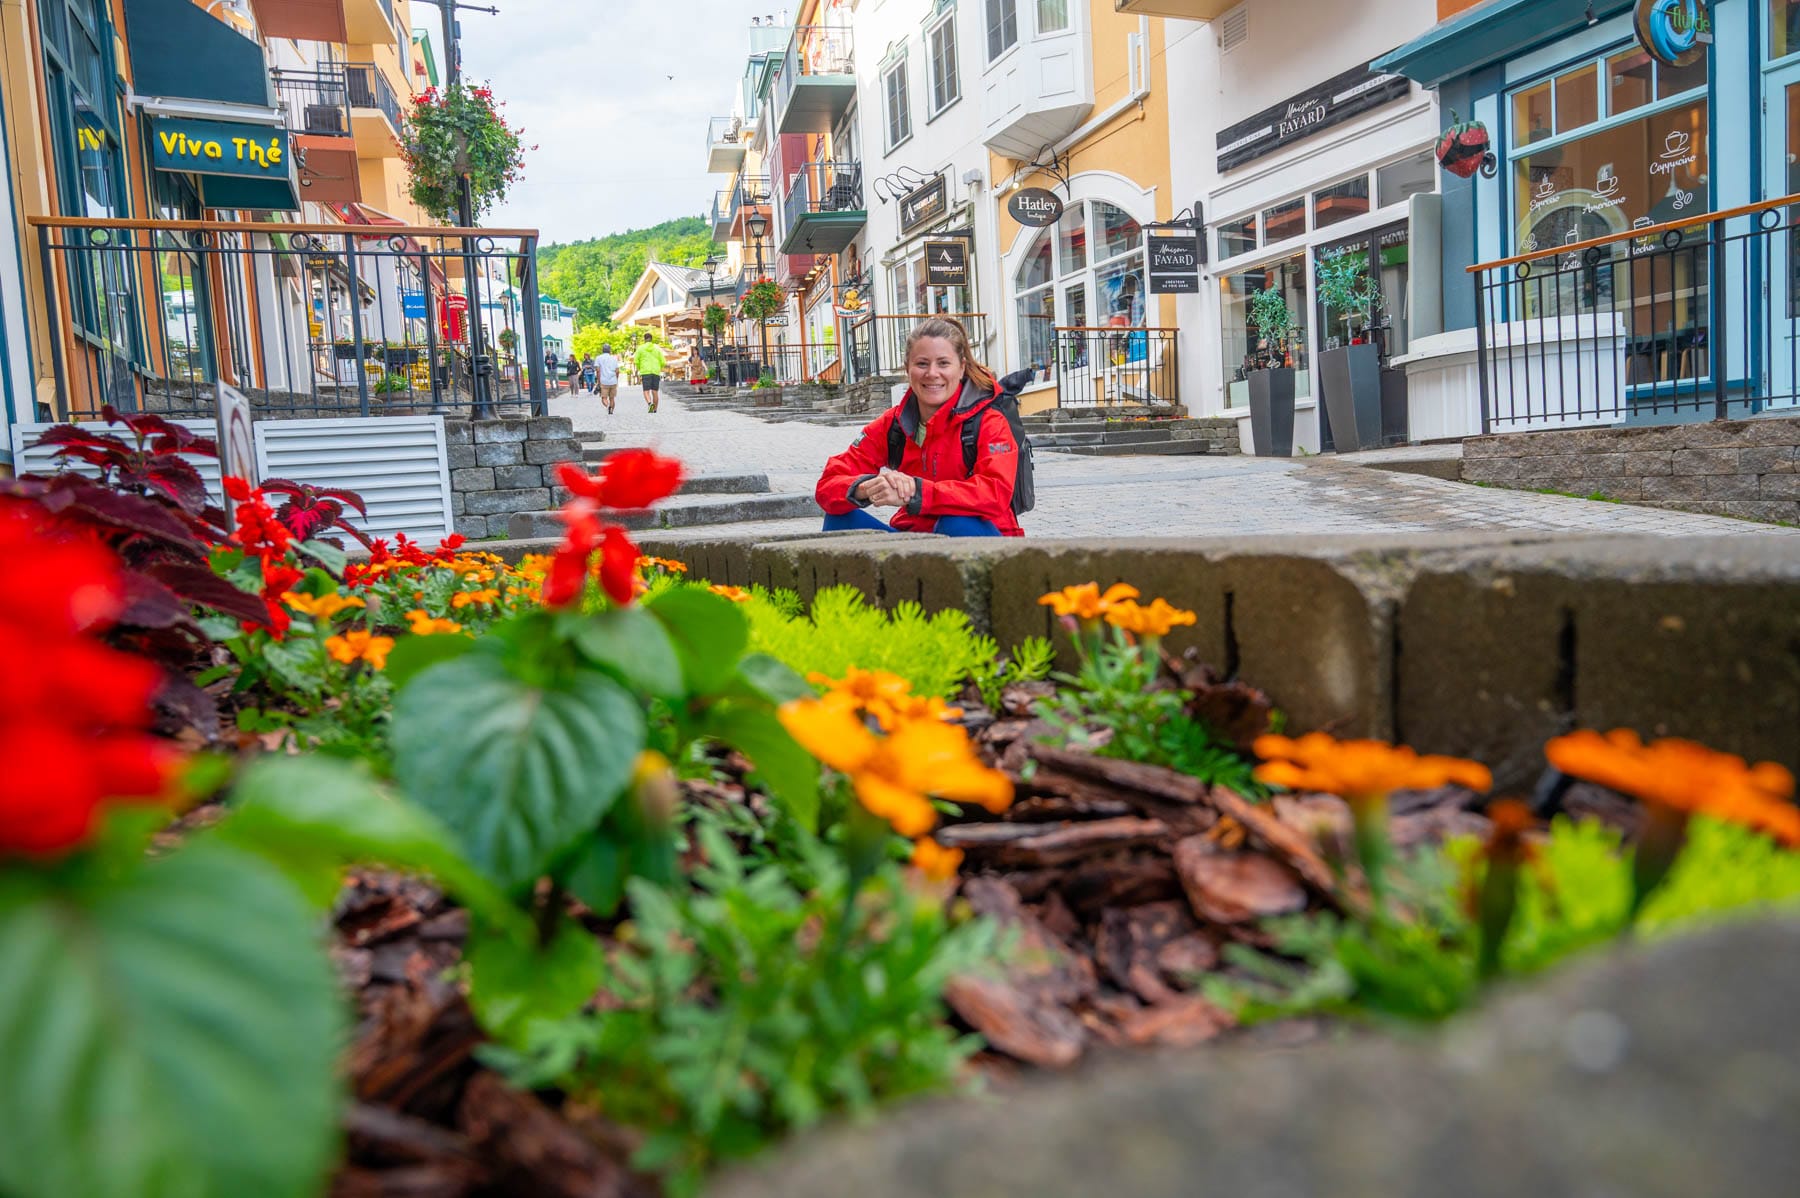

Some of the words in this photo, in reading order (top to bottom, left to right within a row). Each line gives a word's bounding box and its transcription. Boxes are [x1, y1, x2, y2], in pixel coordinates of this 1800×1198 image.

[1285, 98, 1319, 120] Maison
[1279, 104, 1327, 138] FAYARD
[159, 131, 222, 158] Viva
[232, 137, 282, 168] Thé
[1017, 196, 1057, 214] Hatley
[1582, 196, 1627, 215] Americano
[1159, 243, 1188, 256] Maison
[1154, 254, 1194, 266] FAYARD
